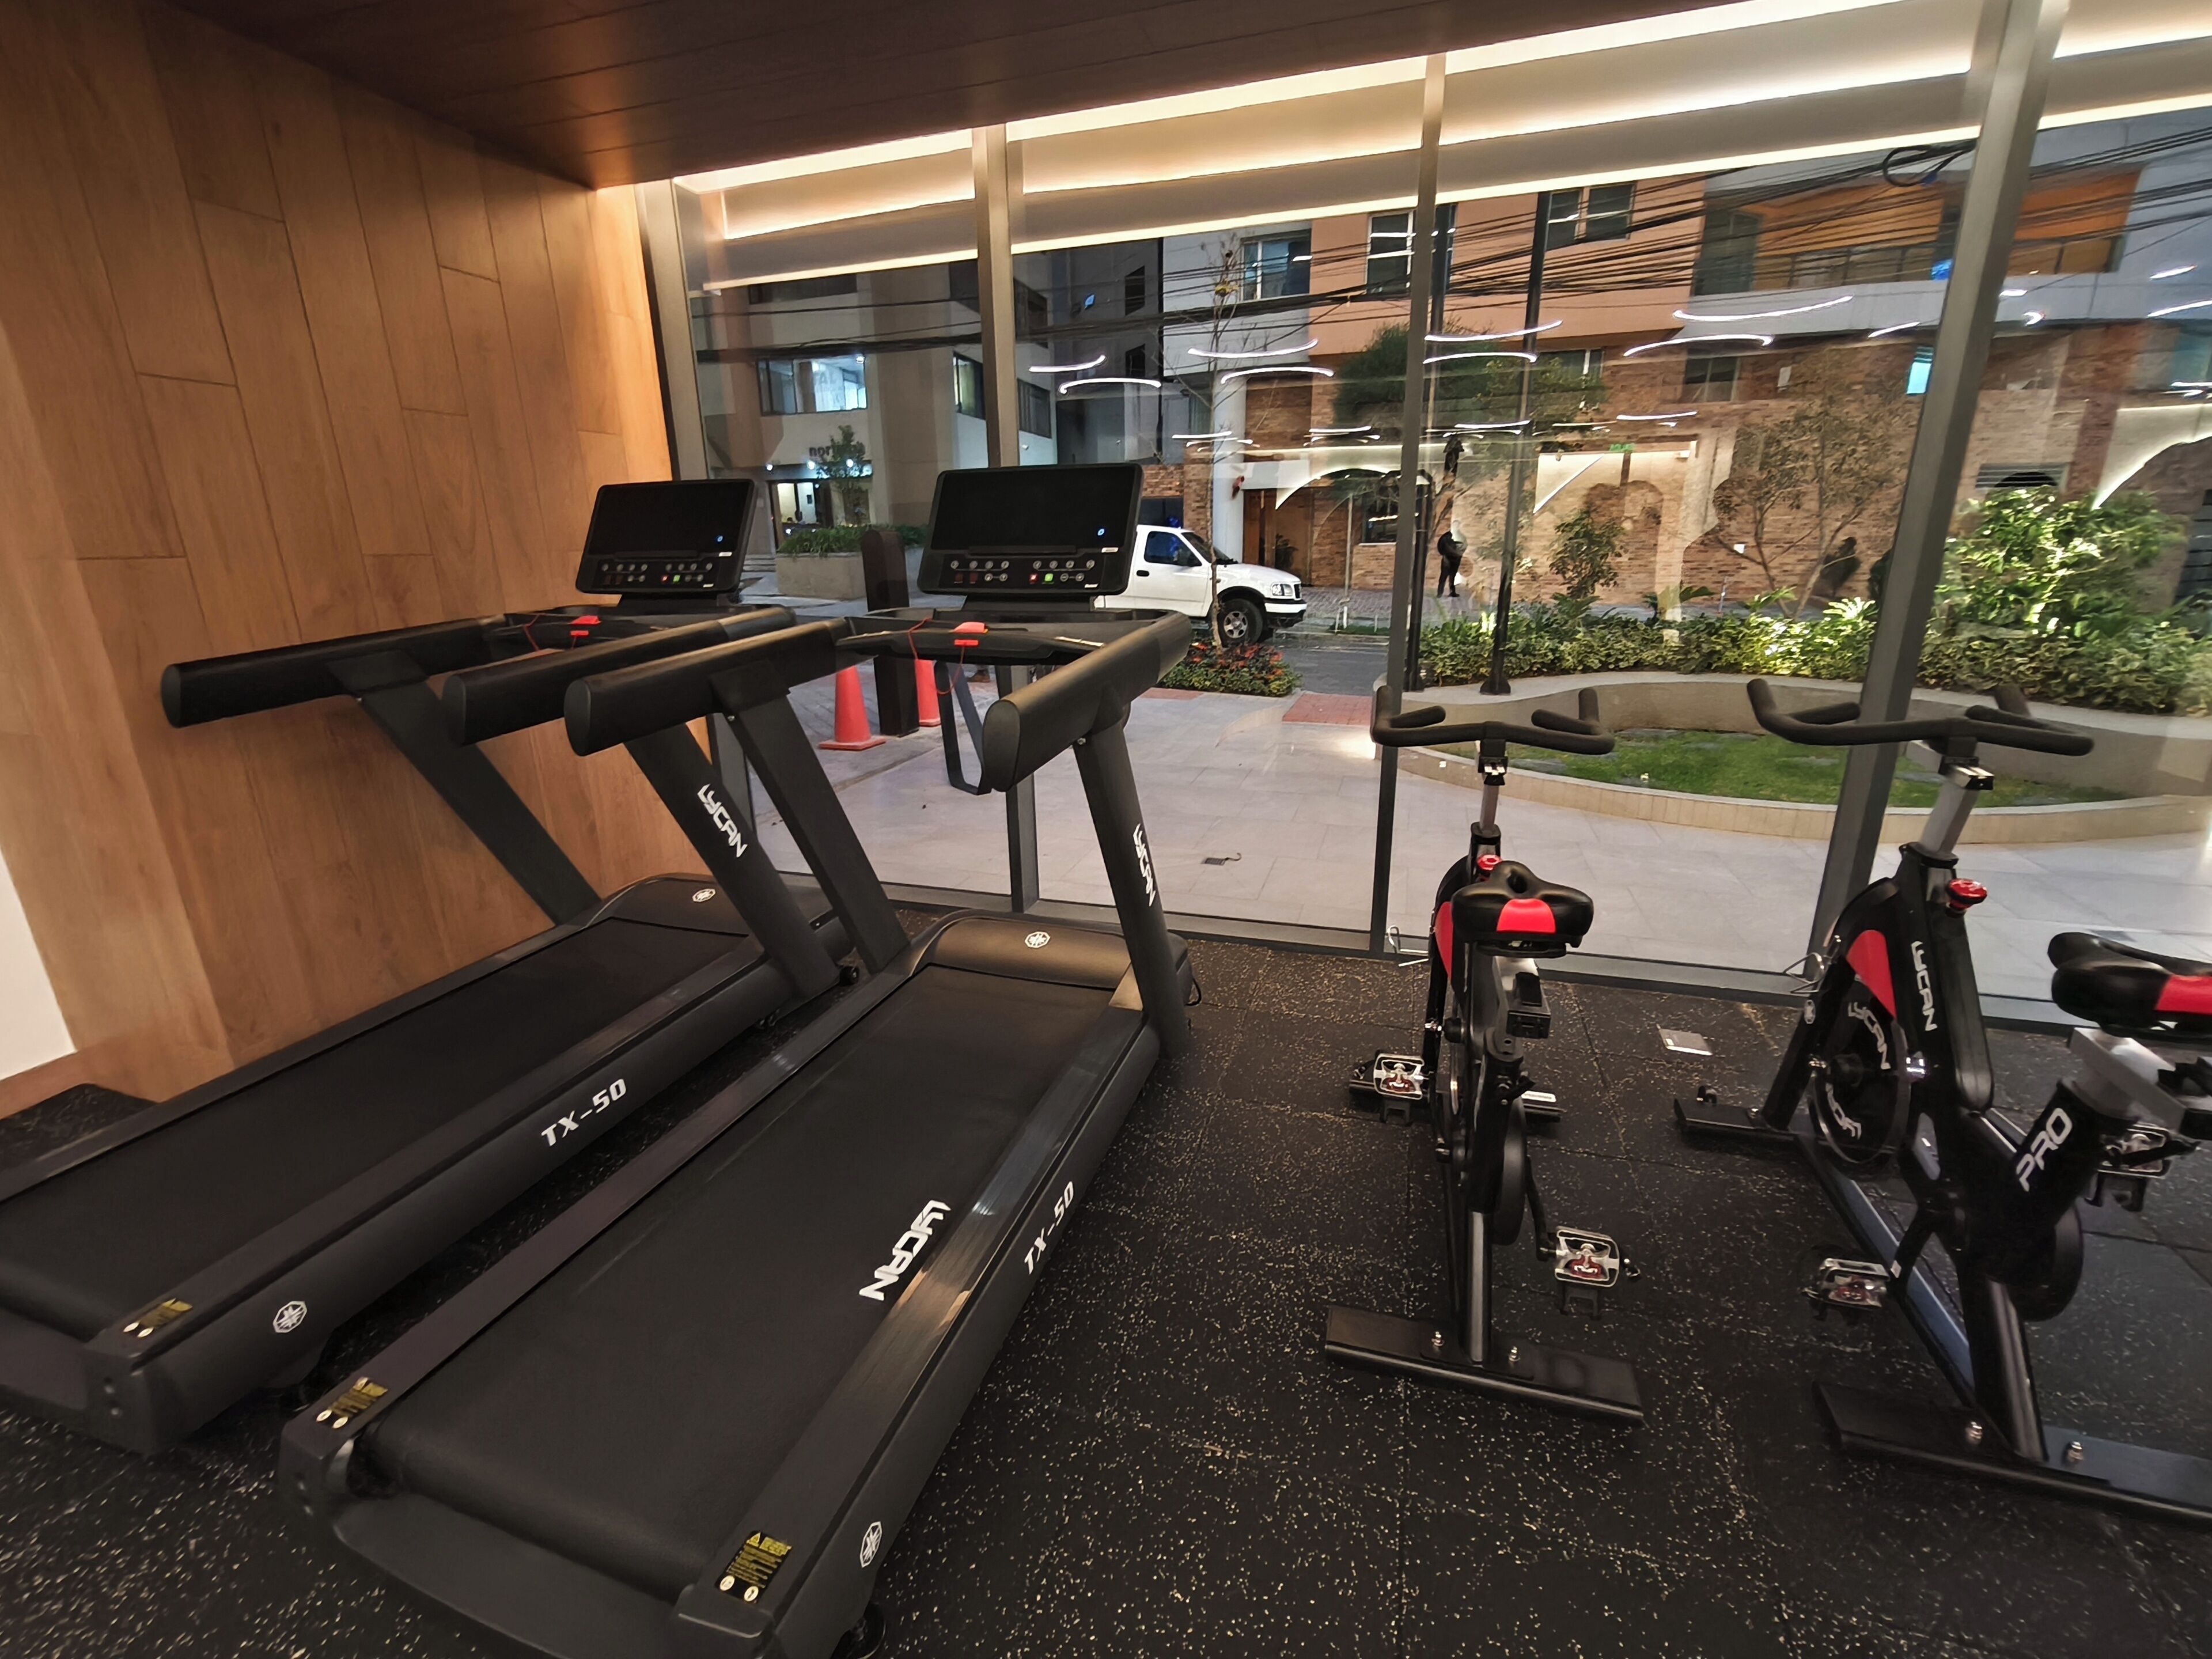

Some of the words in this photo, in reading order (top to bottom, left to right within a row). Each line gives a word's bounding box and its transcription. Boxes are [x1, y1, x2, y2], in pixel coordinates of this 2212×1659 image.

[697, 783, 748, 858] LYCAN
[1132, 823, 1157, 907] LYCAN
[1911, 941, 1938, 1032] LYCAN
[541, 1078, 627, 1147] TX-50
[2015, 1107, 2074, 1192] PRO
[858, 1199, 952, 1301] LYCAN
[1024, 1180, 1074, 1275] TX-50
